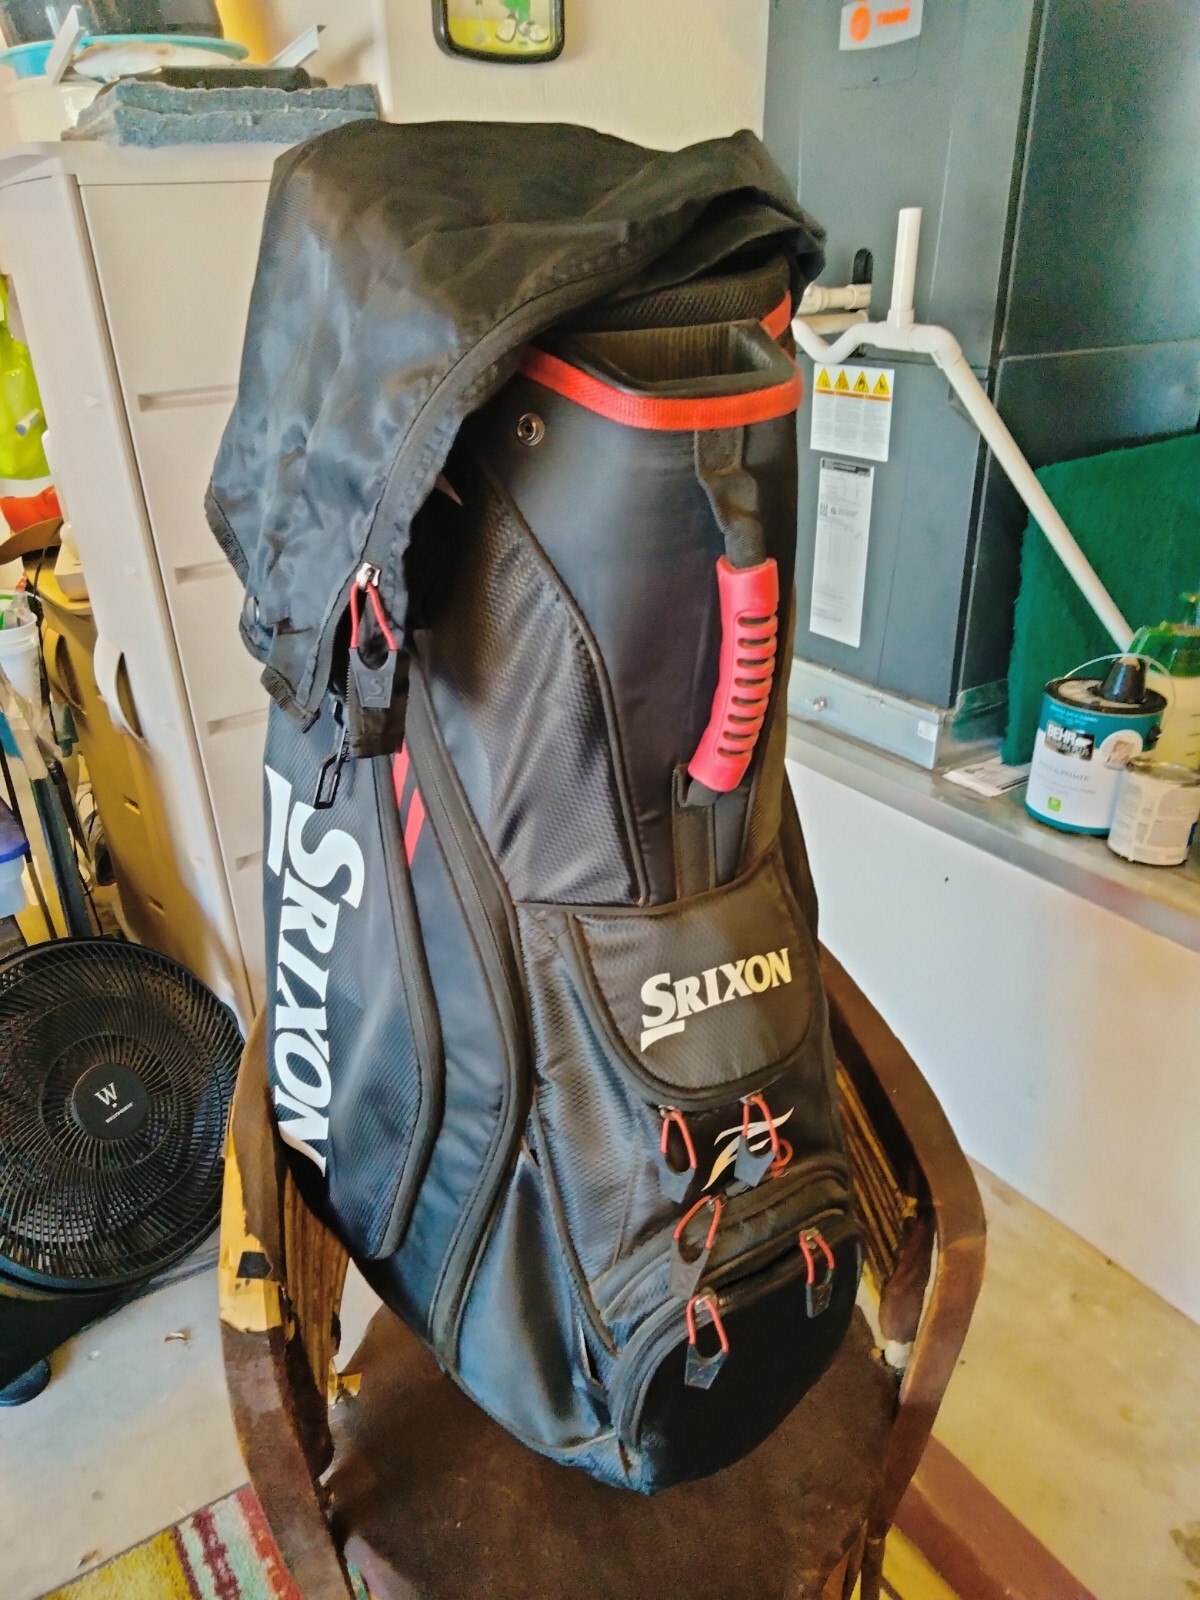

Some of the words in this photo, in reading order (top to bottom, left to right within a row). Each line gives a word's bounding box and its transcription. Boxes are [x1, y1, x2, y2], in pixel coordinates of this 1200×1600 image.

[1046, 722, 1077, 745] BEHR
[272, 800, 365, 1177] SRIXON
[640, 947, 793, 1029] SRIXON
[94, 1082, 117, 1105] W
